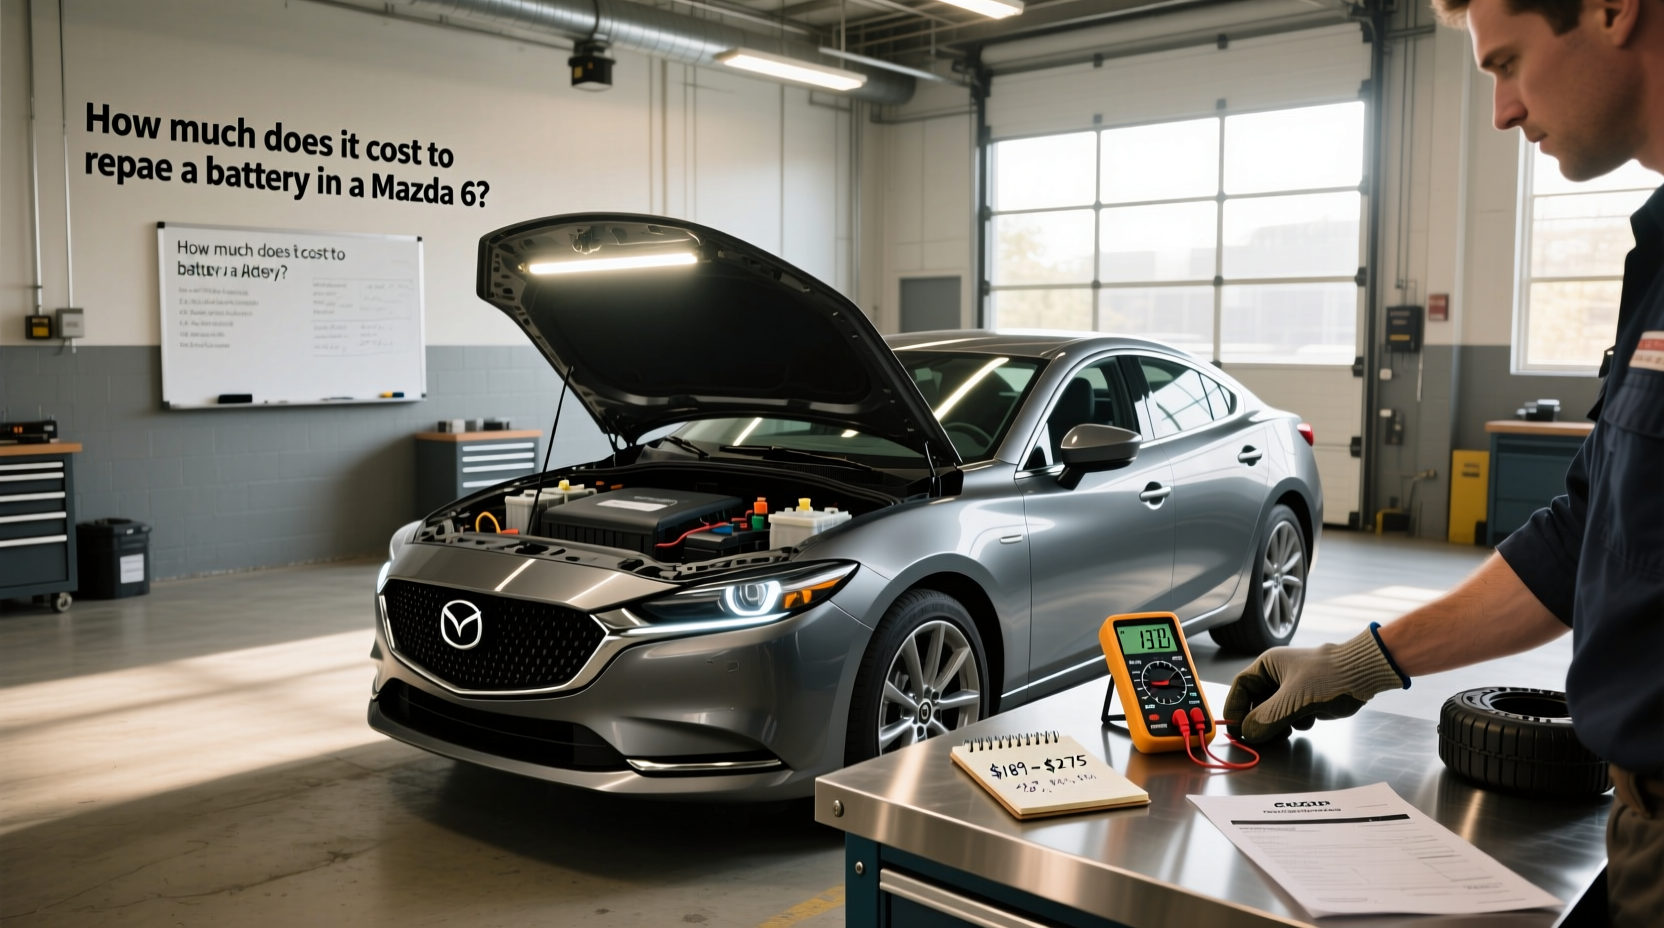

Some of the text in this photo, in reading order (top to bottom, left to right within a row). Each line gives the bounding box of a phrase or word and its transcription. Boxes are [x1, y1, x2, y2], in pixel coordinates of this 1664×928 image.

[86, 102, 454, 168] How much does it cost to
[85, 152, 490, 208] repae a battery in a Mazda 6?
[177, 240, 210, 256] How
[214, 243, 253, 257] much
[257, 243, 291, 259] does
[301, 247, 328, 260] cost
[330, 247, 346, 261] to
[989, 762, 1028, 780] $189
[1043, 754, 1088, 774] $275
